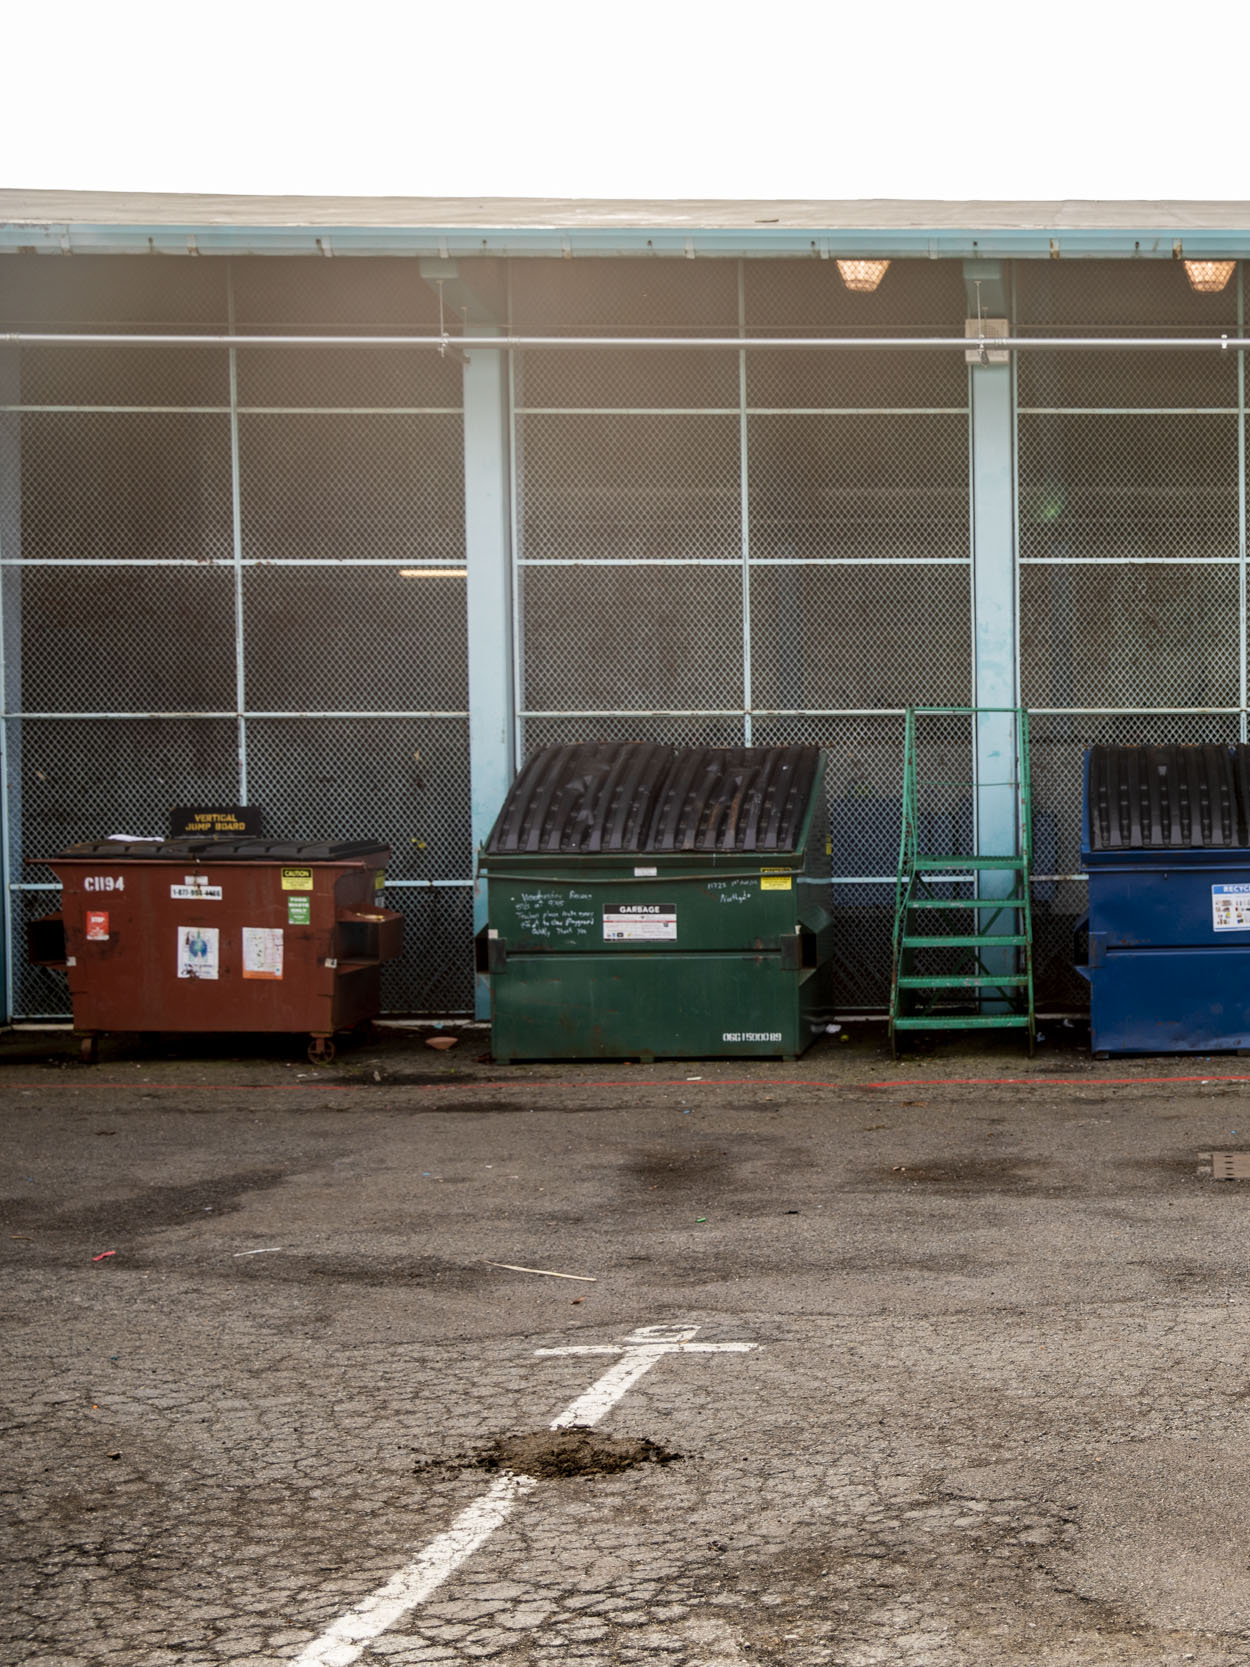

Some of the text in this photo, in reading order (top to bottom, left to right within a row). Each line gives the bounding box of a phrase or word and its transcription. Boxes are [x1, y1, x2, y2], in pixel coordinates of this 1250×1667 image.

[194, 814, 238, 822] VERTICAL
[185, 822, 246, 831] JUMP BOARD
[619, 905, 660, 914] GARBAGE
